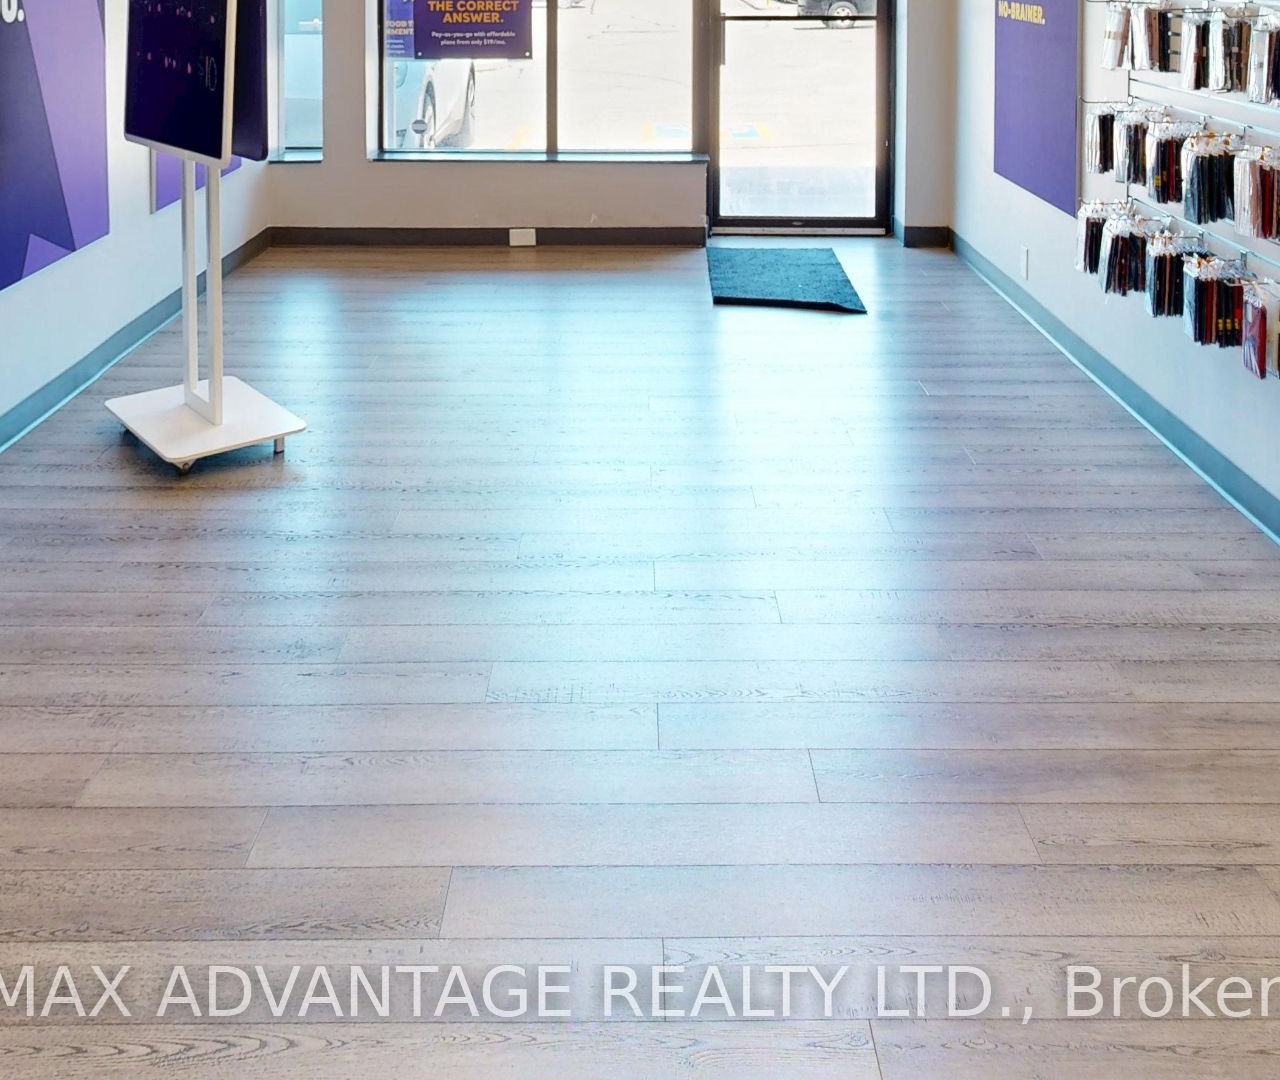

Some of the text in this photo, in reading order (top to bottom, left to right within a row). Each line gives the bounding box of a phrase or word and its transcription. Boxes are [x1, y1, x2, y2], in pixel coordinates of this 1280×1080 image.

[427, 0, 519, 11] THE CORRECT
[442, 13, 504, 23] ANSWER.
[998, 0, 1045, 25] NO-BRAINER.
